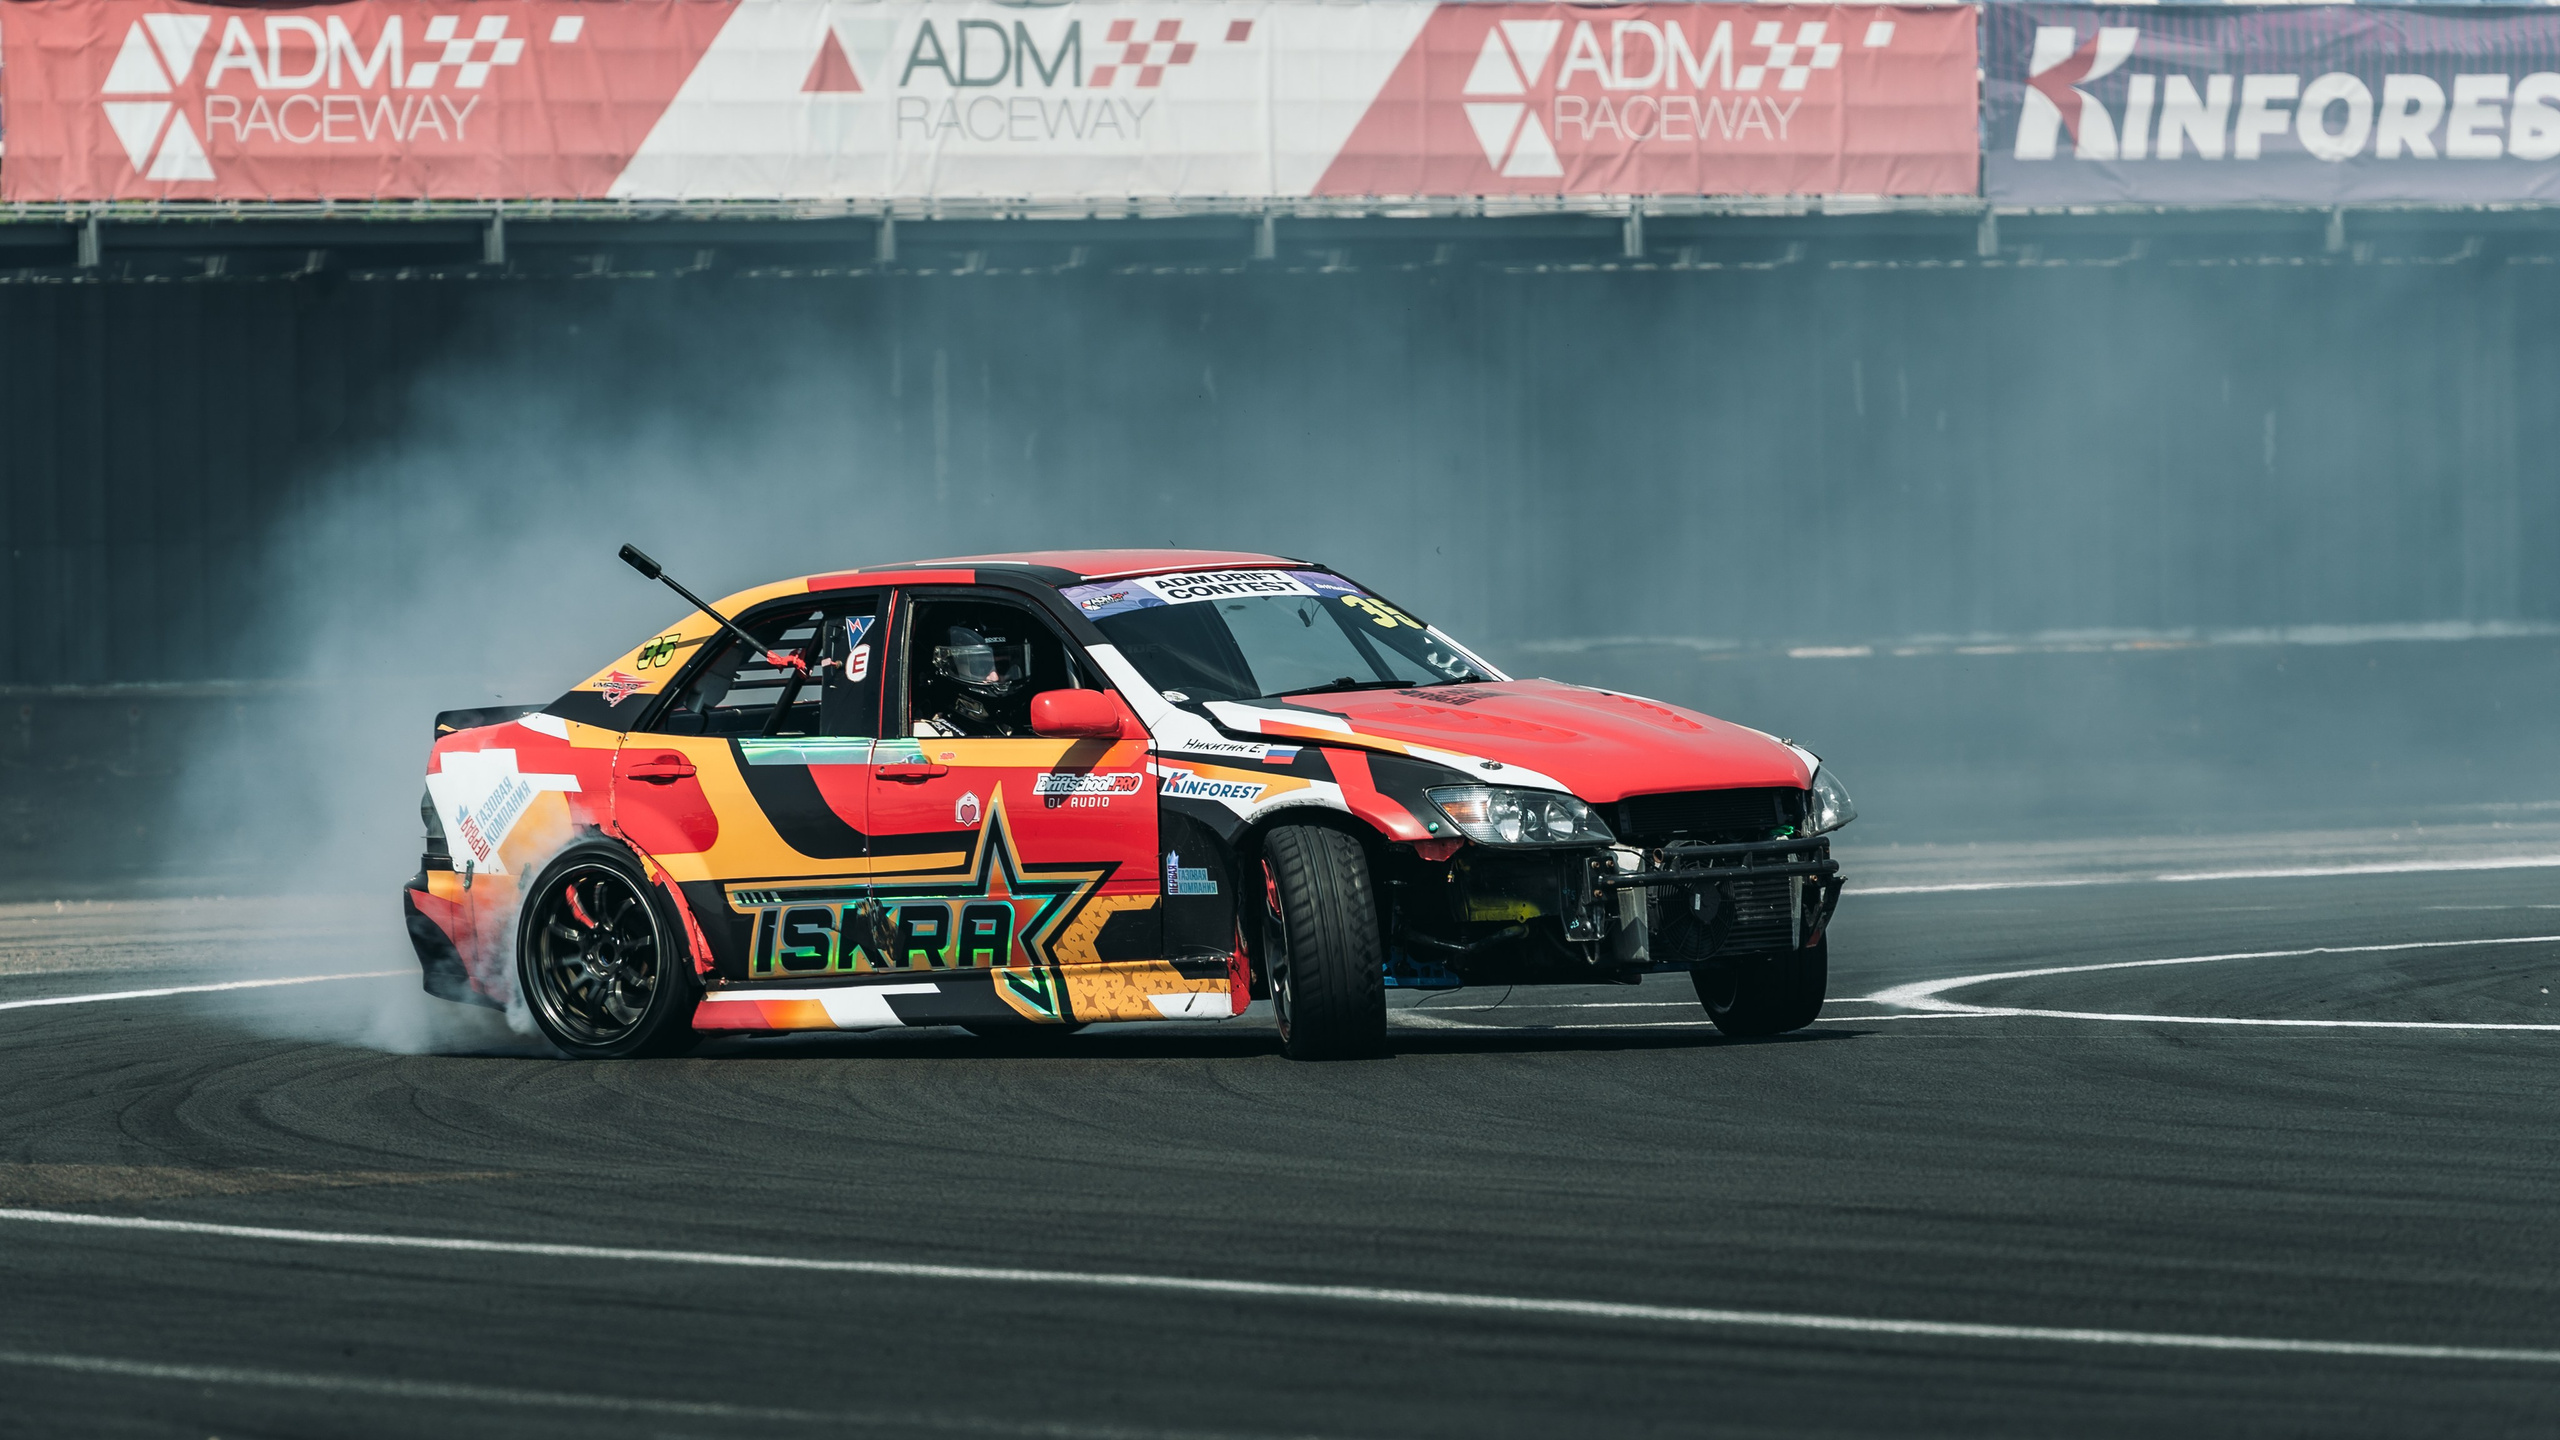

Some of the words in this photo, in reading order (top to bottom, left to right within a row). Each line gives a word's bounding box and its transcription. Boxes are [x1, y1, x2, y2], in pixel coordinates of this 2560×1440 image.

[206, 15, 405, 89] ADM
[900, 19, 1082, 88] ADM
[1557, 20, 1734, 90] ADM
[204, 96, 480, 143] RACEWAY
[897, 97, 1155, 142] RACEWAY
[1554, 97, 1801, 142] RACEWAY
[1155, 575, 1214, 589] ADM
[1211, 572, 1282, 583] DRIFT
[1167, 581, 1299, 599] CONTEST
[1340, 594, 1424, 629] 35
[637, 633, 681, 670] 35
[852, 652, 867, 674] E
[475, 776, 513, 829] ГАЗОВАЯ
[1070, 796, 1110, 808] AUDIO
[1164, 772, 1262, 799] KINFOREST
[484, 780, 531, 846] КОМПАНИЯ
[460, 815, 491, 863] ПЕРВАЯ
[1167, 865, 1179, 894] ПЕРВАЯ
[1179, 869, 1207, 881] ГАЗОВАЯ
[1179, 882, 1217, 894] КОМПАНИЯ
[755, 902, 1014, 974] ISKRA
